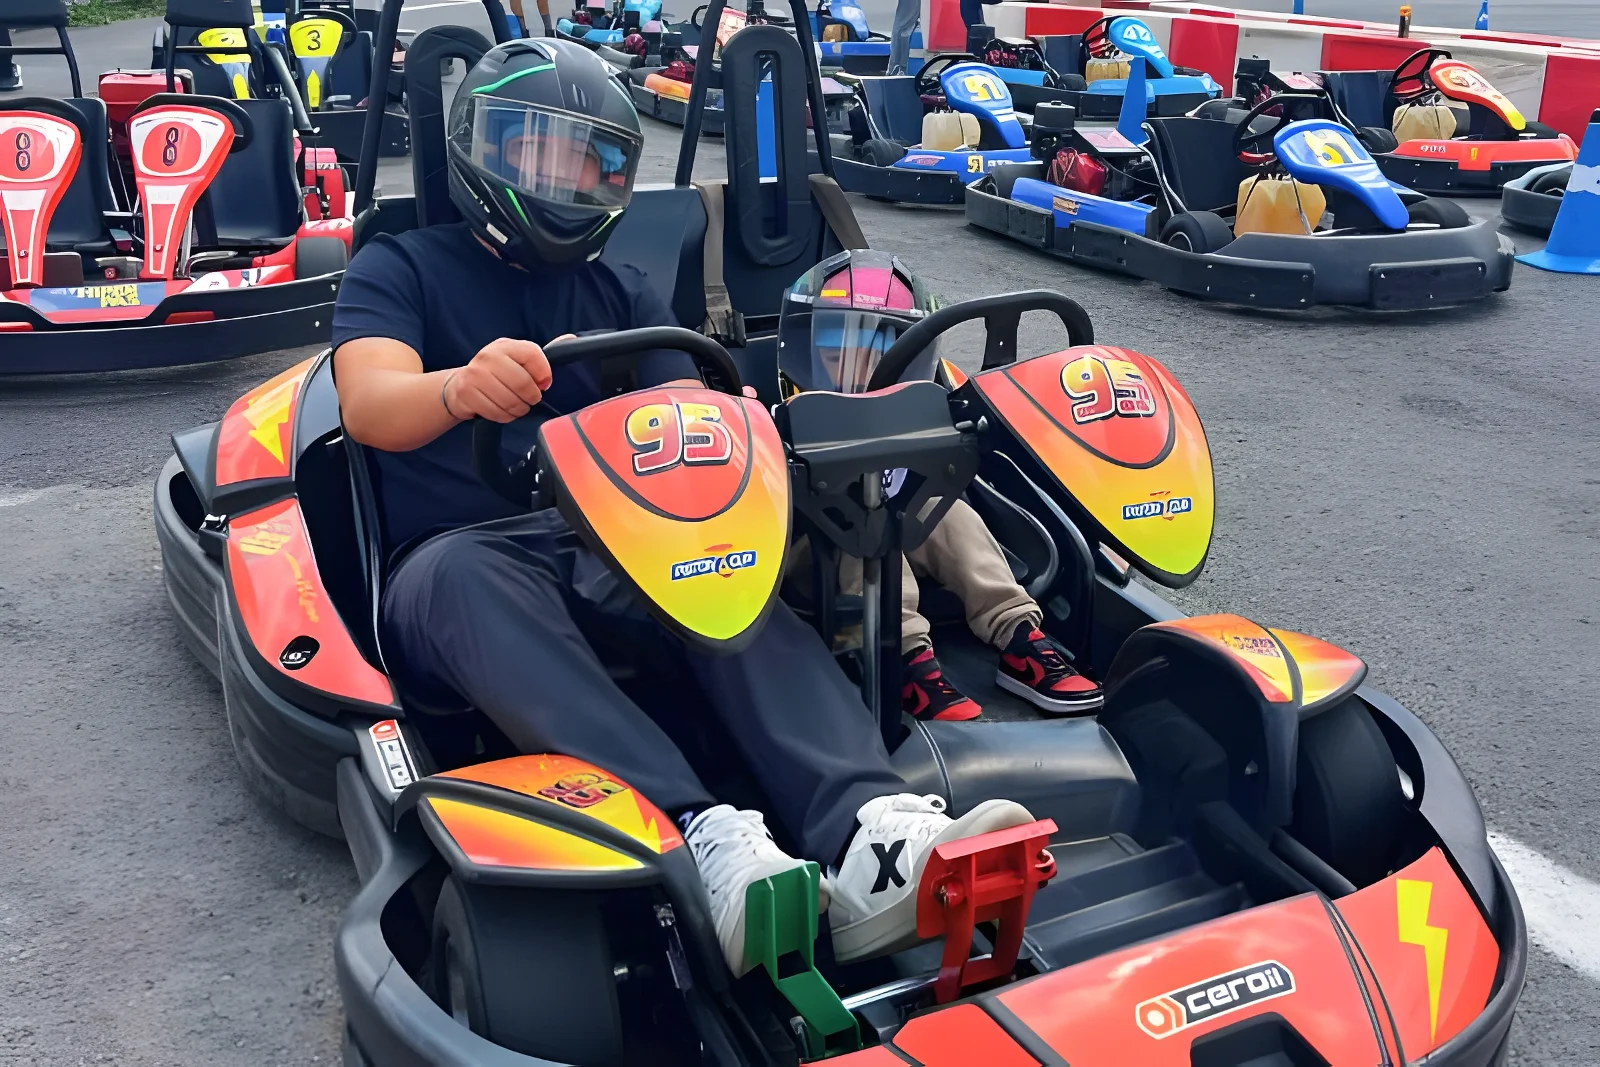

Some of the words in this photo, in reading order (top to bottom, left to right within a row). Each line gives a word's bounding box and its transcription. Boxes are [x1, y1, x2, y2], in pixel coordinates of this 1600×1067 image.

[307, 29, 321, 51] 3
[1060, 356, 1156, 425] 95
[625, 402, 732, 476] 95
[870, 838, 907, 895] X
[1186, 967, 1284, 1014] ceroil
